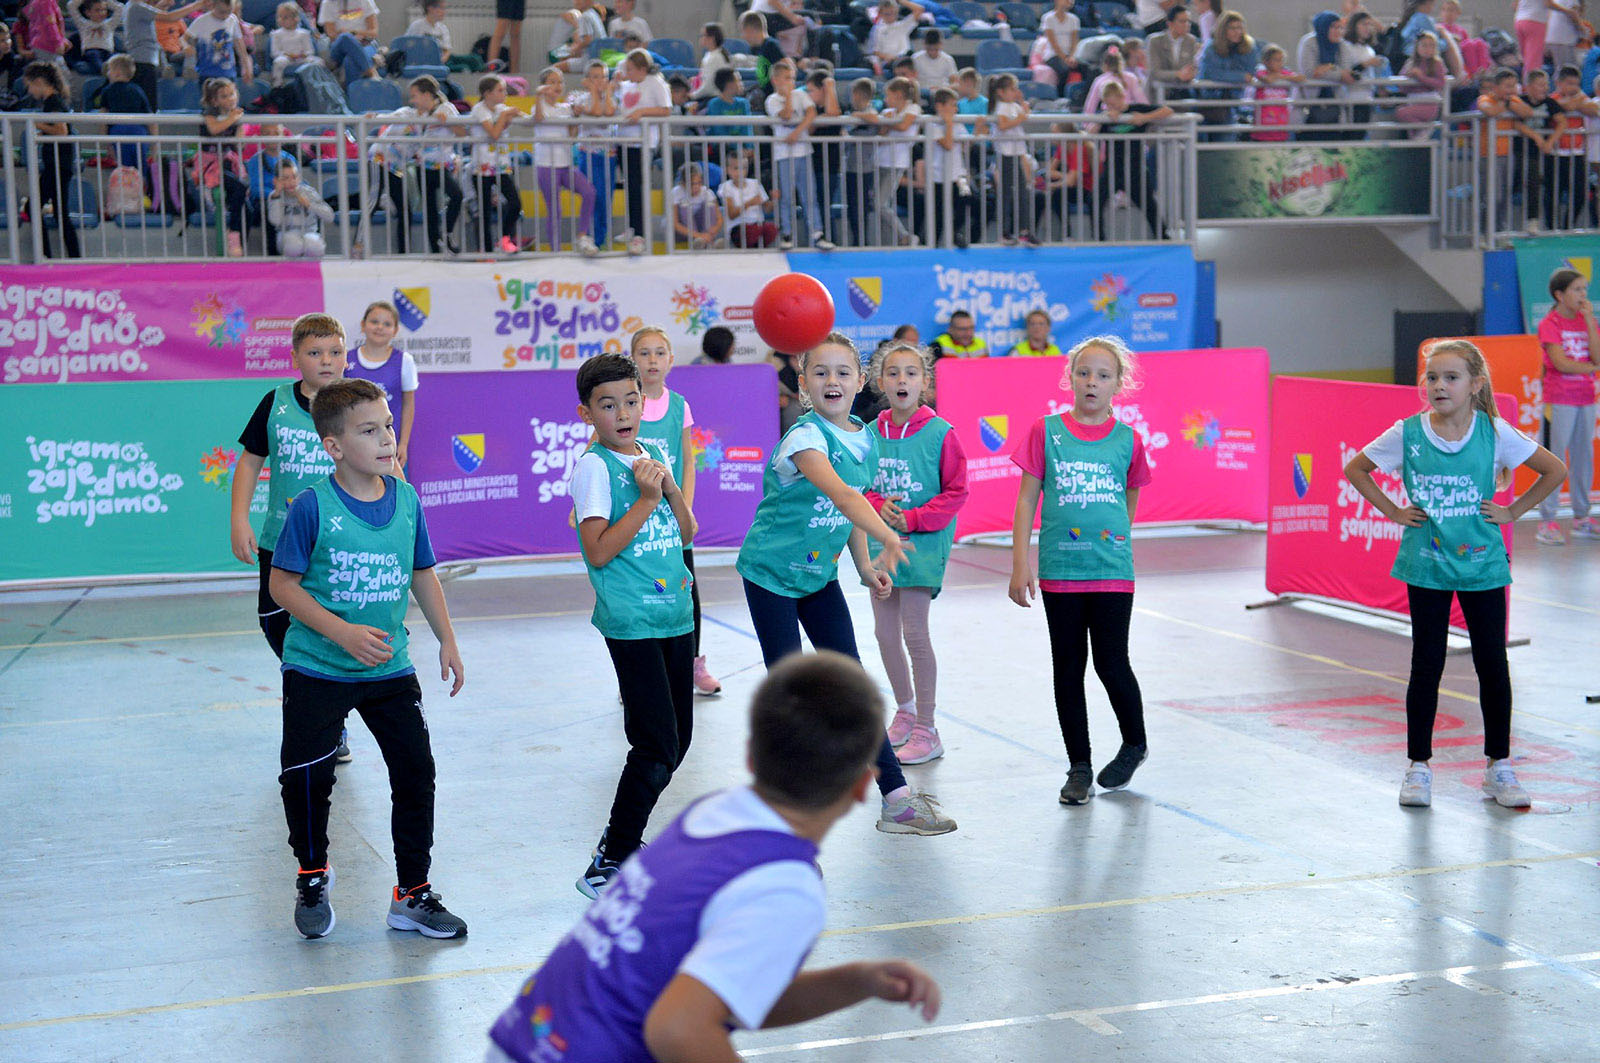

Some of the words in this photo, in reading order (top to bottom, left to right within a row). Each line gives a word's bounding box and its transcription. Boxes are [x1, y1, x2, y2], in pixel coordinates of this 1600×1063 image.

[493, 274, 611, 310] igramo.
[495, 298, 620, 344] zajedno
[4, 344, 148, 383] sanjamo.
[26, 435, 148, 470] igramo.
[1053, 459, 1112, 477] igramo.
[28, 457, 159, 501] zajedno
[37, 490, 168, 527] sanjamo.
[328, 563, 402, 592] zajedno
